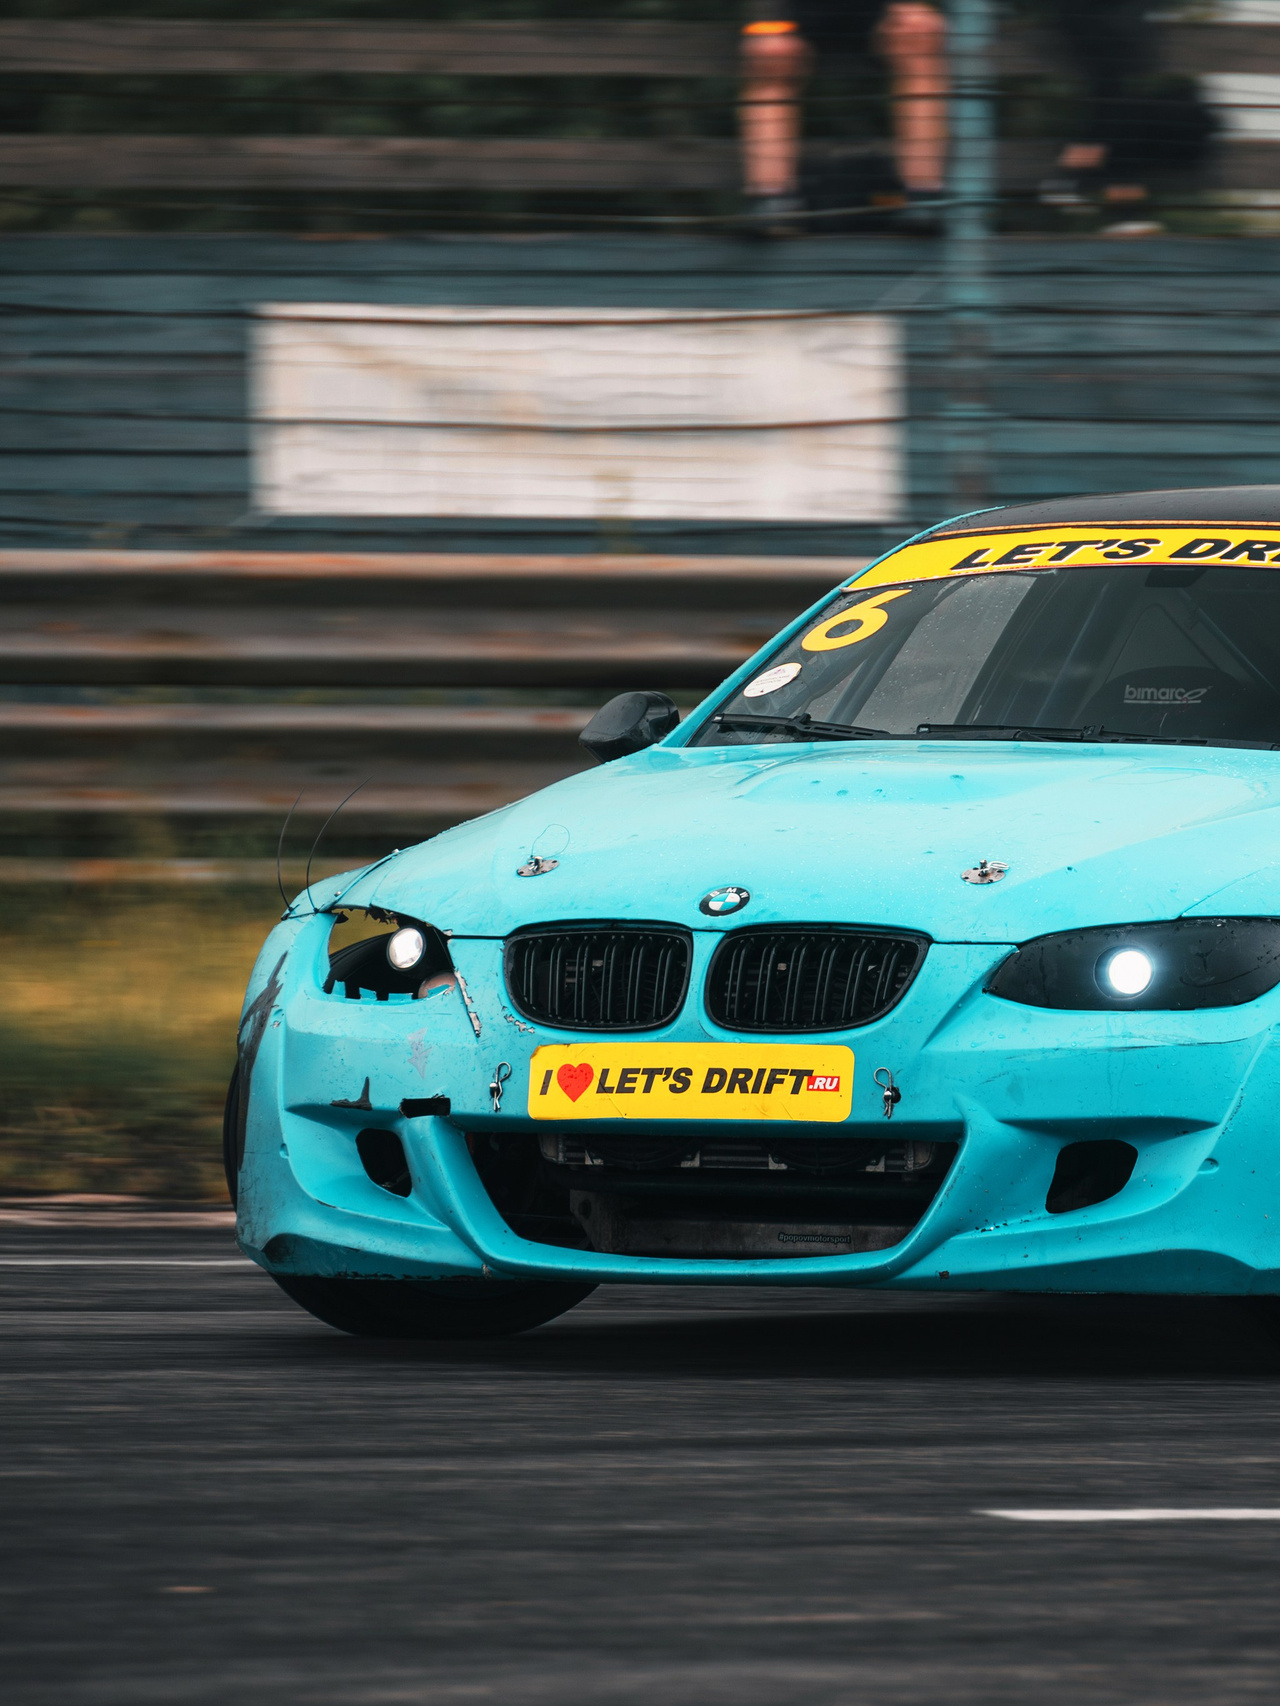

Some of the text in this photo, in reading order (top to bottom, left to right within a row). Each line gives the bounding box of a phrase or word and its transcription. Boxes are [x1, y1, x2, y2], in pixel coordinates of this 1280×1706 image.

[951, 537, 1161, 570] LET'S
[801, 589, 912, 651] 6
[539, 1069, 553, 1096] I
[595, 1067, 692, 1094] LET'S
[779, 1233, 851, 1245] #popovmotorsport
